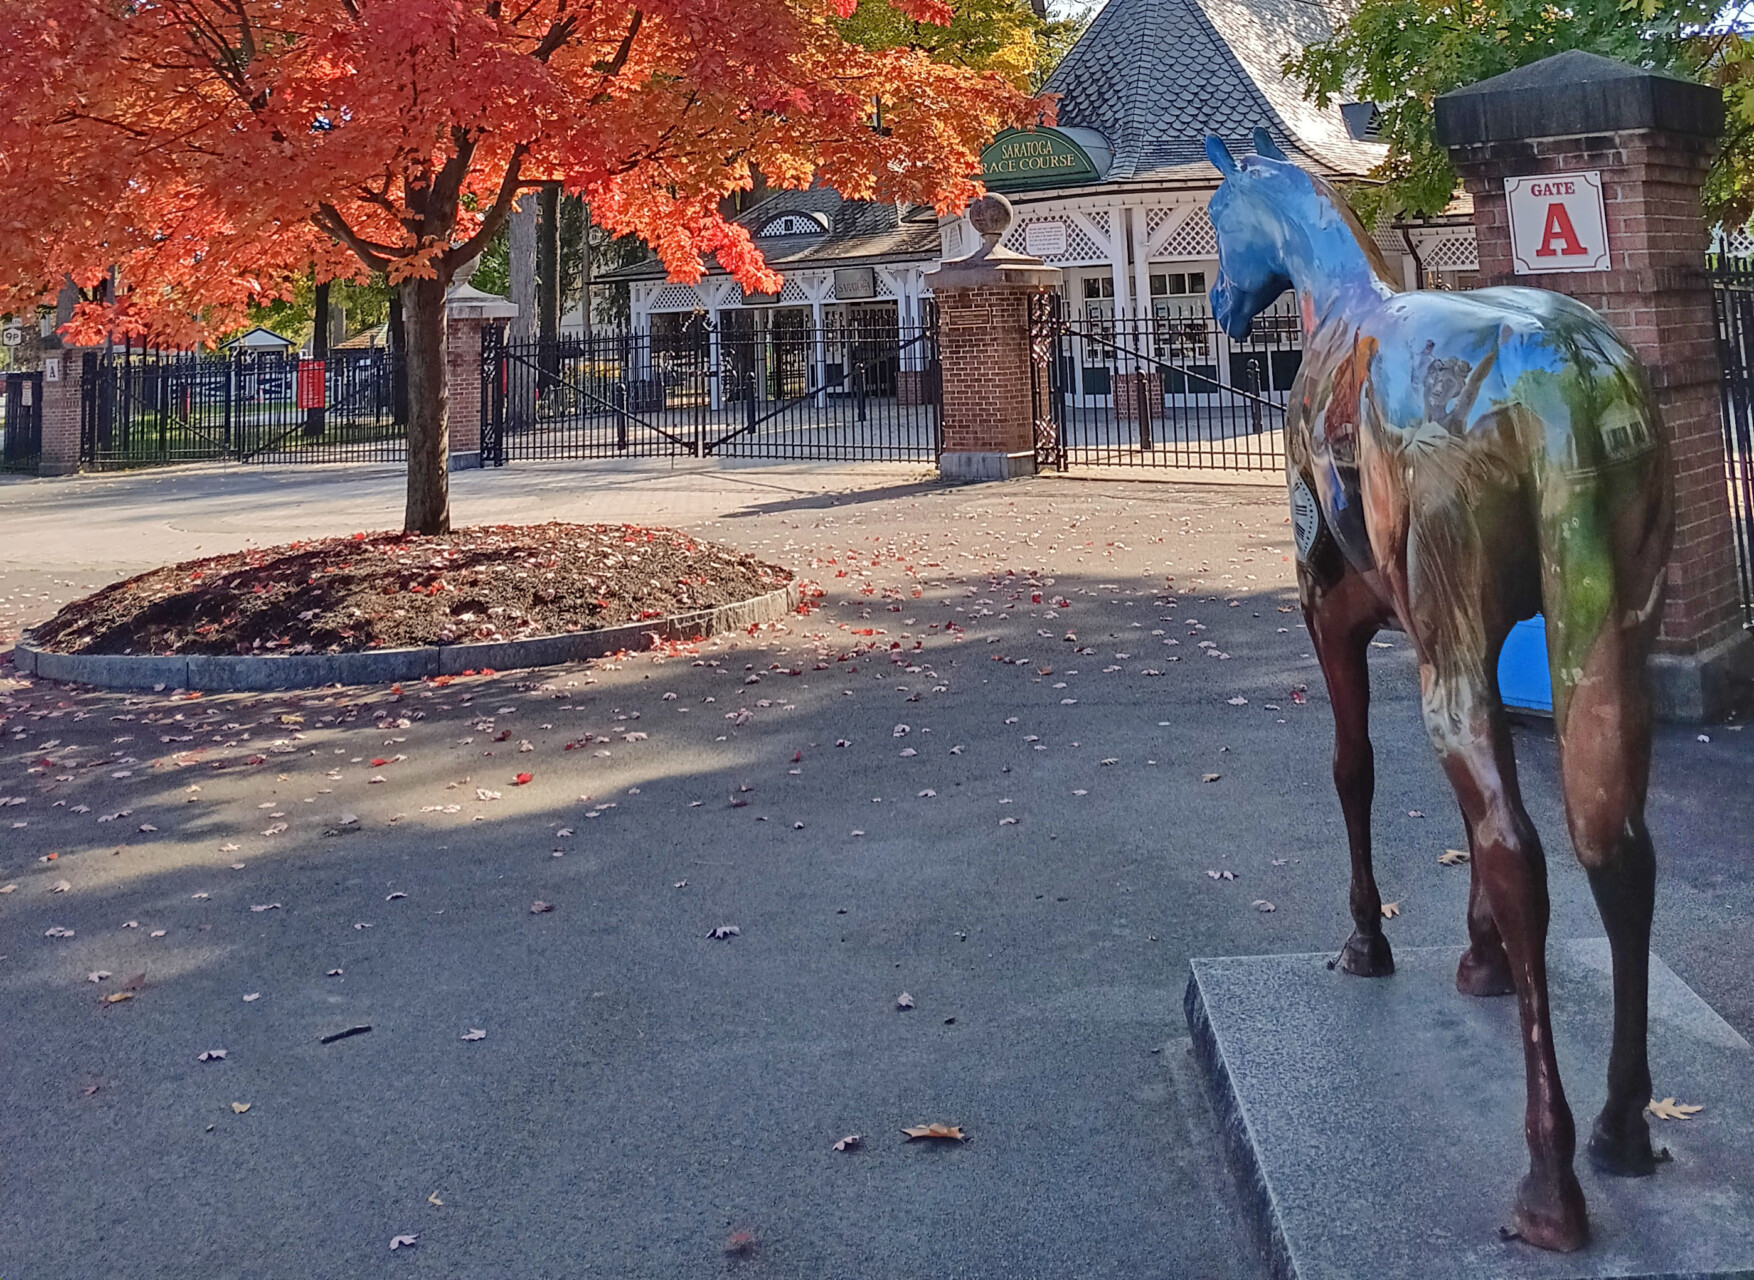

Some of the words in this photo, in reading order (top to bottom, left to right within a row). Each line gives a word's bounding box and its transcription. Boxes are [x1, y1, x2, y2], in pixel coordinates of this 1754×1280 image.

[1001, 140, 1053, 159] SARATOGA
[982, 160, 1016, 174] RACE
[1019, 154, 1075, 170] COURSE
[1530, 182, 1576, 197] GATE
[1535, 203, 1588, 257] A
[5, 332, 19, 341] 9P
[49, 365, 56, 378] A
